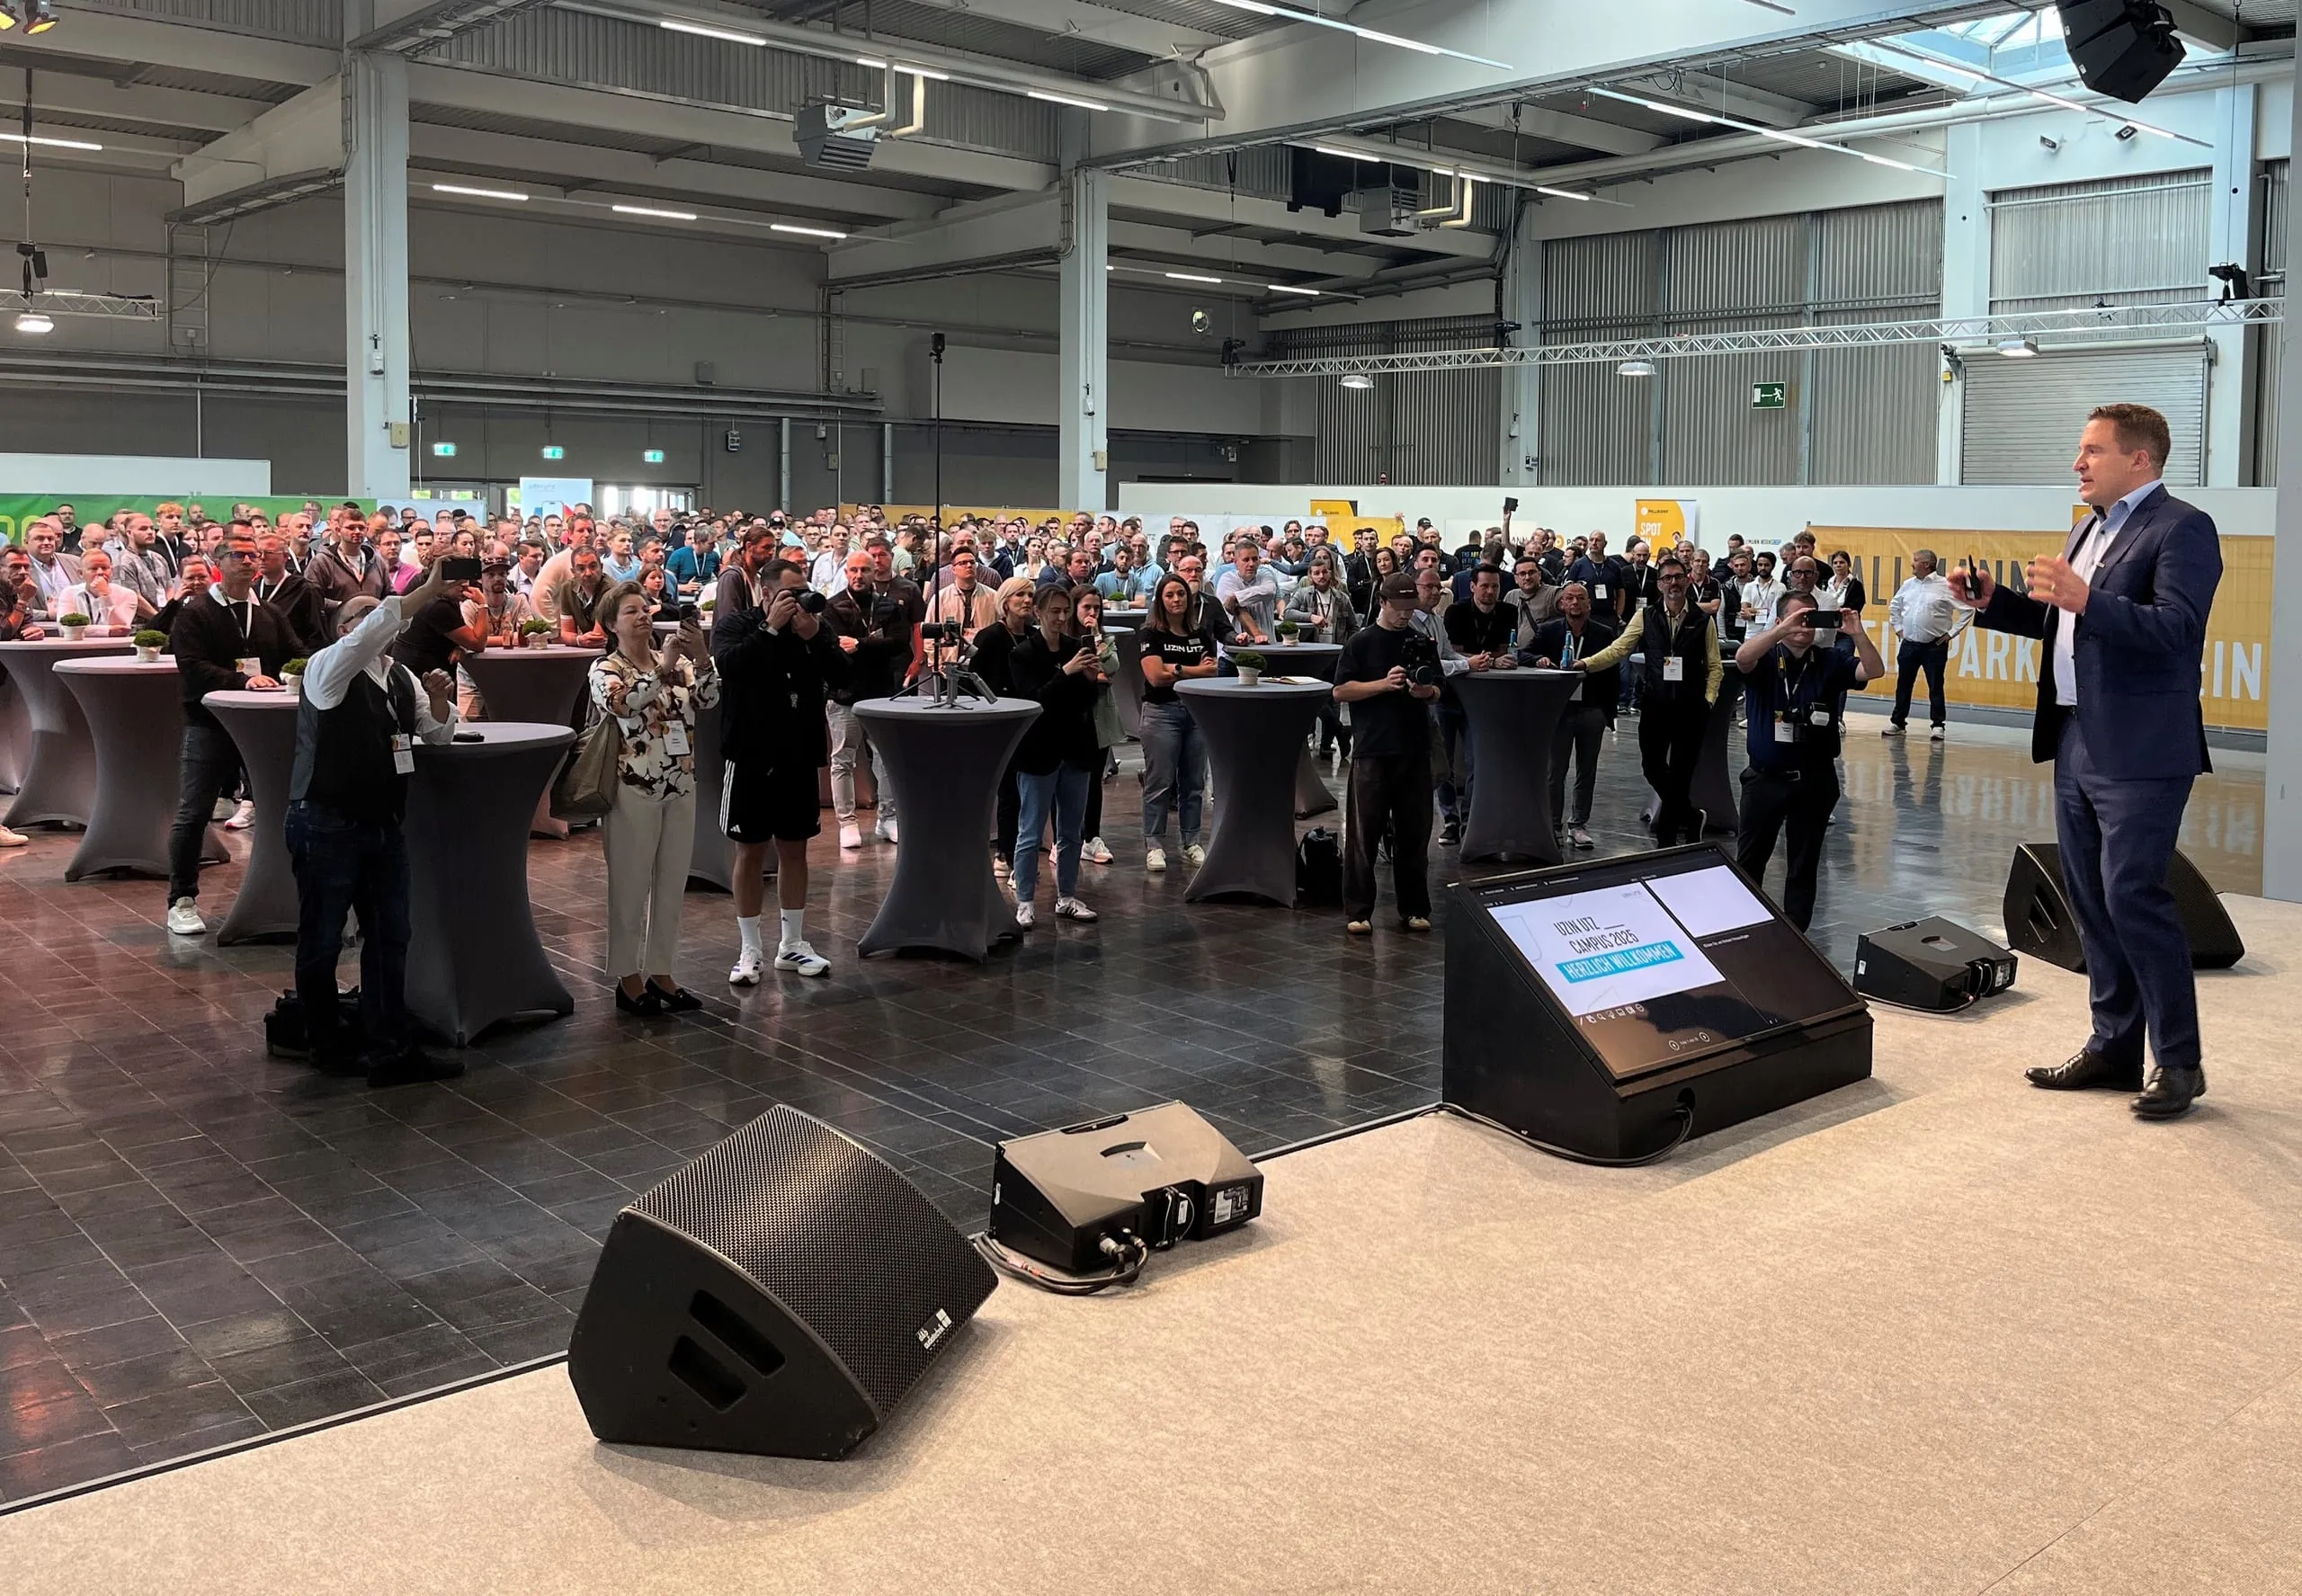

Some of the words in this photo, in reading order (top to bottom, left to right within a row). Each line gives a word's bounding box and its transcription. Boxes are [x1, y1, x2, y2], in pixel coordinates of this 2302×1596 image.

[1640, 522, 1663, 537] SPOT
[1164, 643, 1185, 653] UZIN
[2199, 639, 2262, 700] IN
[1554, 919, 1584, 936] UZIN
[1581, 916, 1601, 932] UTZ
[1569, 933, 1612, 954] CAMPUS
[1610, 929, 1639, 947] 2025
[1563, 956, 1615, 979] HERZLICH
[1611, 944, 1678, 970] WILLKOMMEN
